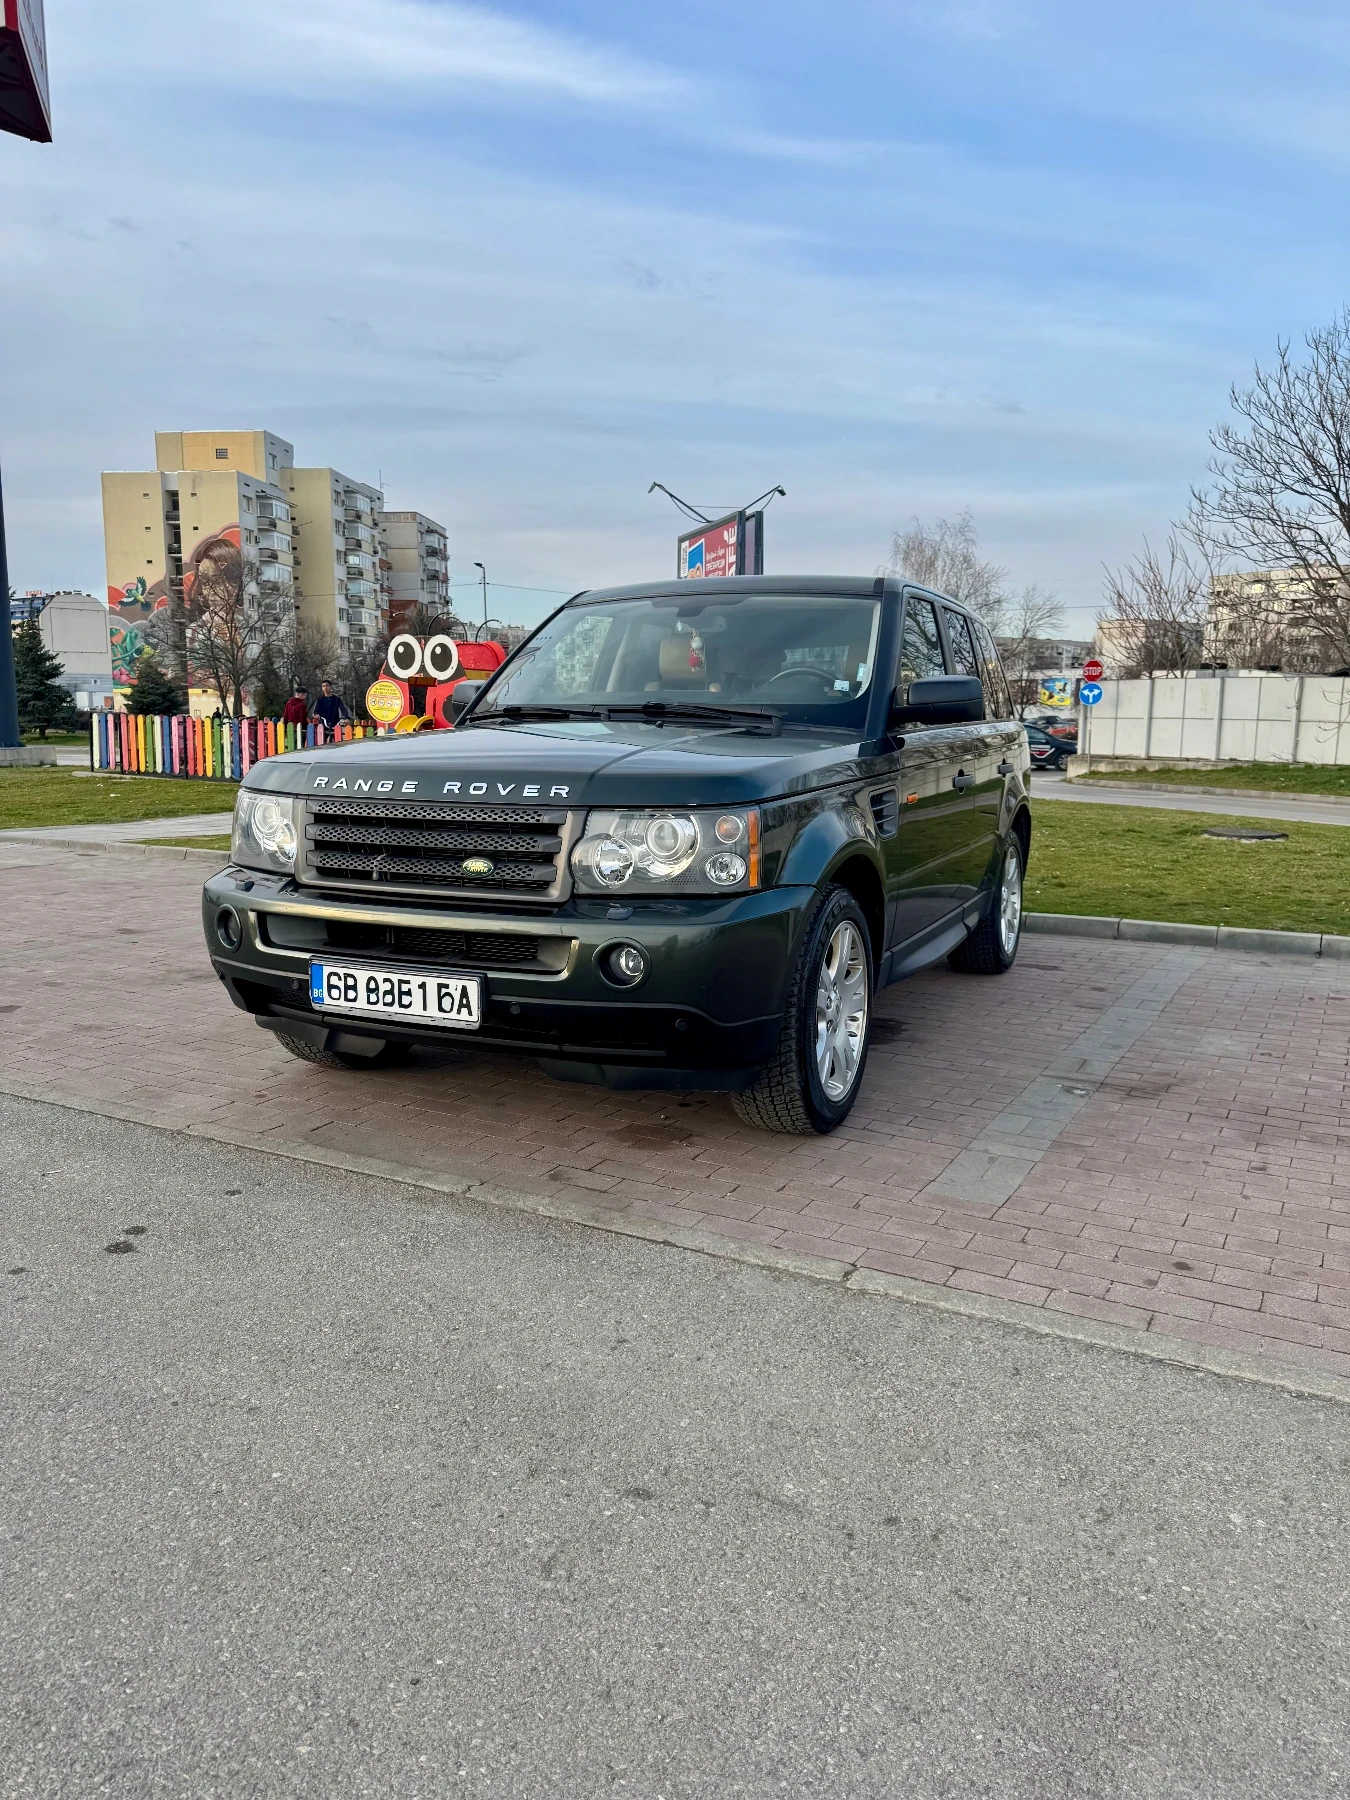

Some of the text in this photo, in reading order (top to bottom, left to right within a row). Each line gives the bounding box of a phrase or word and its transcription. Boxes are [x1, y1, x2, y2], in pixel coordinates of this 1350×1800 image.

[1084, 666, 1102, 675] STOP
[313, 776, 570, 798] RANGE ROVER
[313, 989, 323, 998] BG
